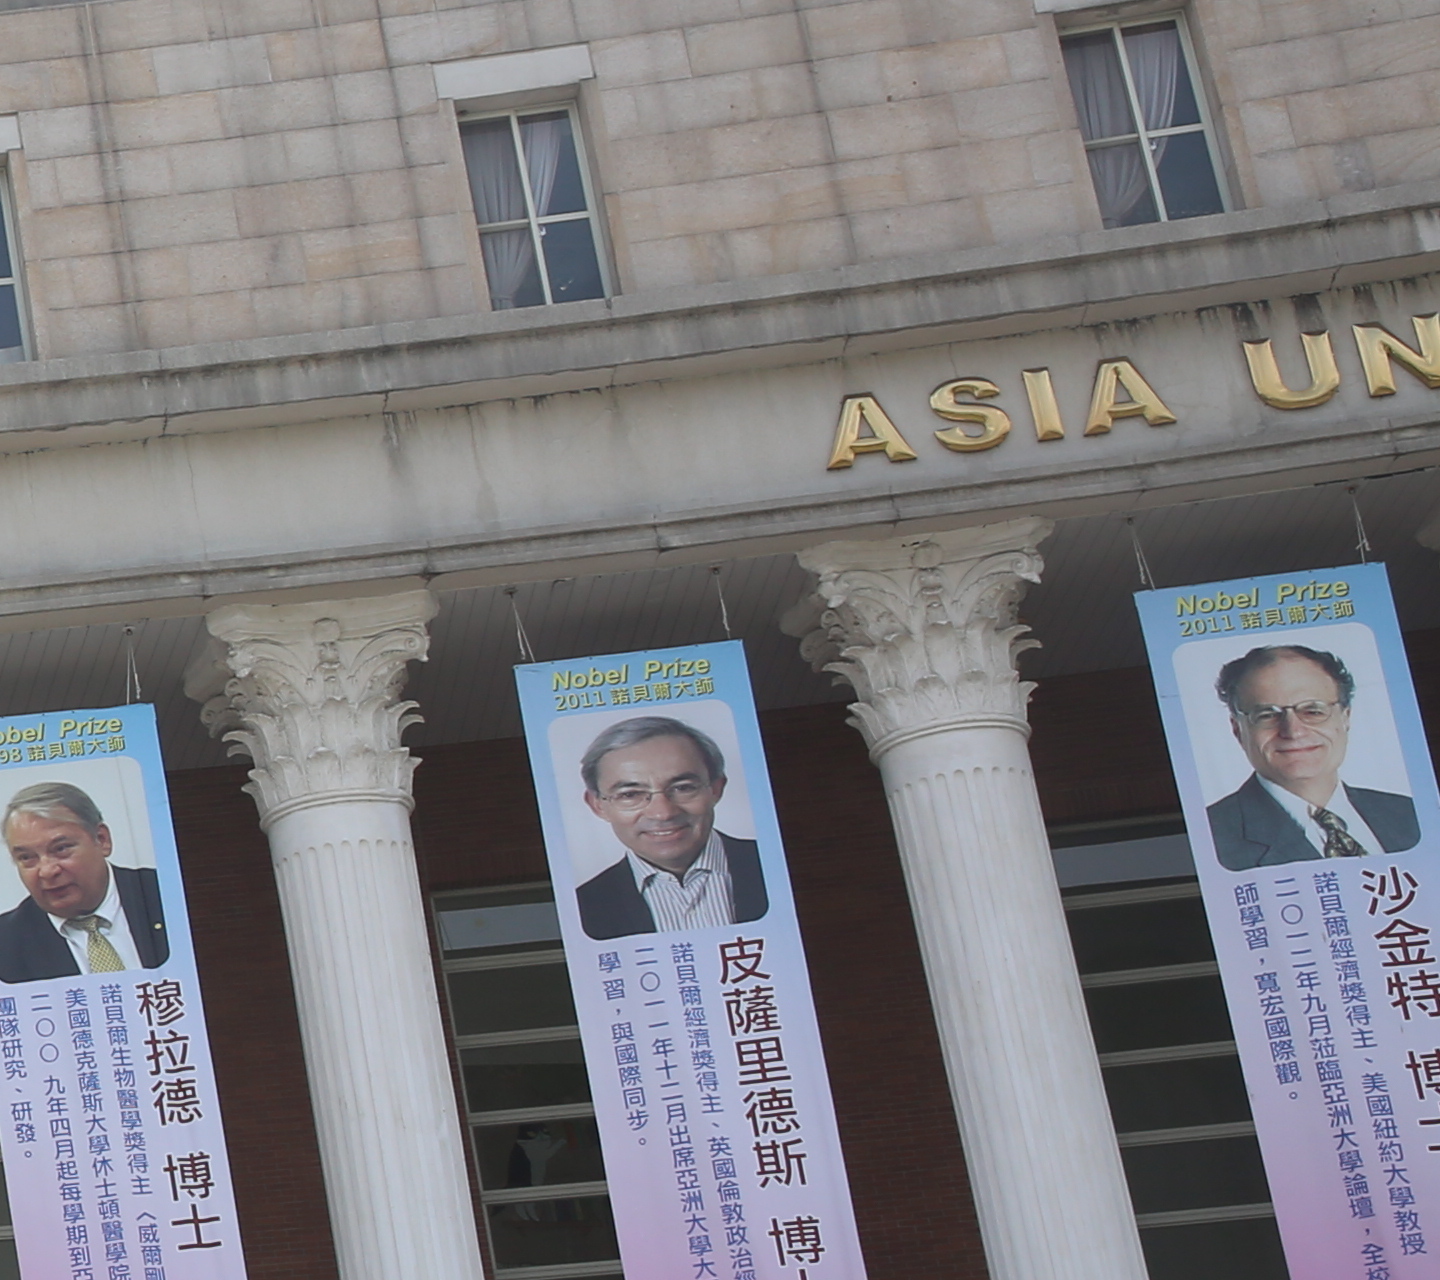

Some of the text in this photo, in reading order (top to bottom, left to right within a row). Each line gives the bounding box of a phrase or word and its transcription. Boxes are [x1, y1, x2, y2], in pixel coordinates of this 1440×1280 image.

[827, 356, 1177, 471] ASIA
[1176, 580, 1350, 616] Nobel Prize
[1180, 600, 1354, 636] 2011 諾貝爾大師
[552, 659, 710, 691] Nobel Prize
[554, 678, 714, 711] 2011 諾貝爾大師
[60, 716, 122, 738] Prize
[27, 736, 126, 761] 諾貝爾大師
[718, 936, 808, 1188] 皮薩里德斯
[135, 980, 222, 1251] 穆拉德 博士
